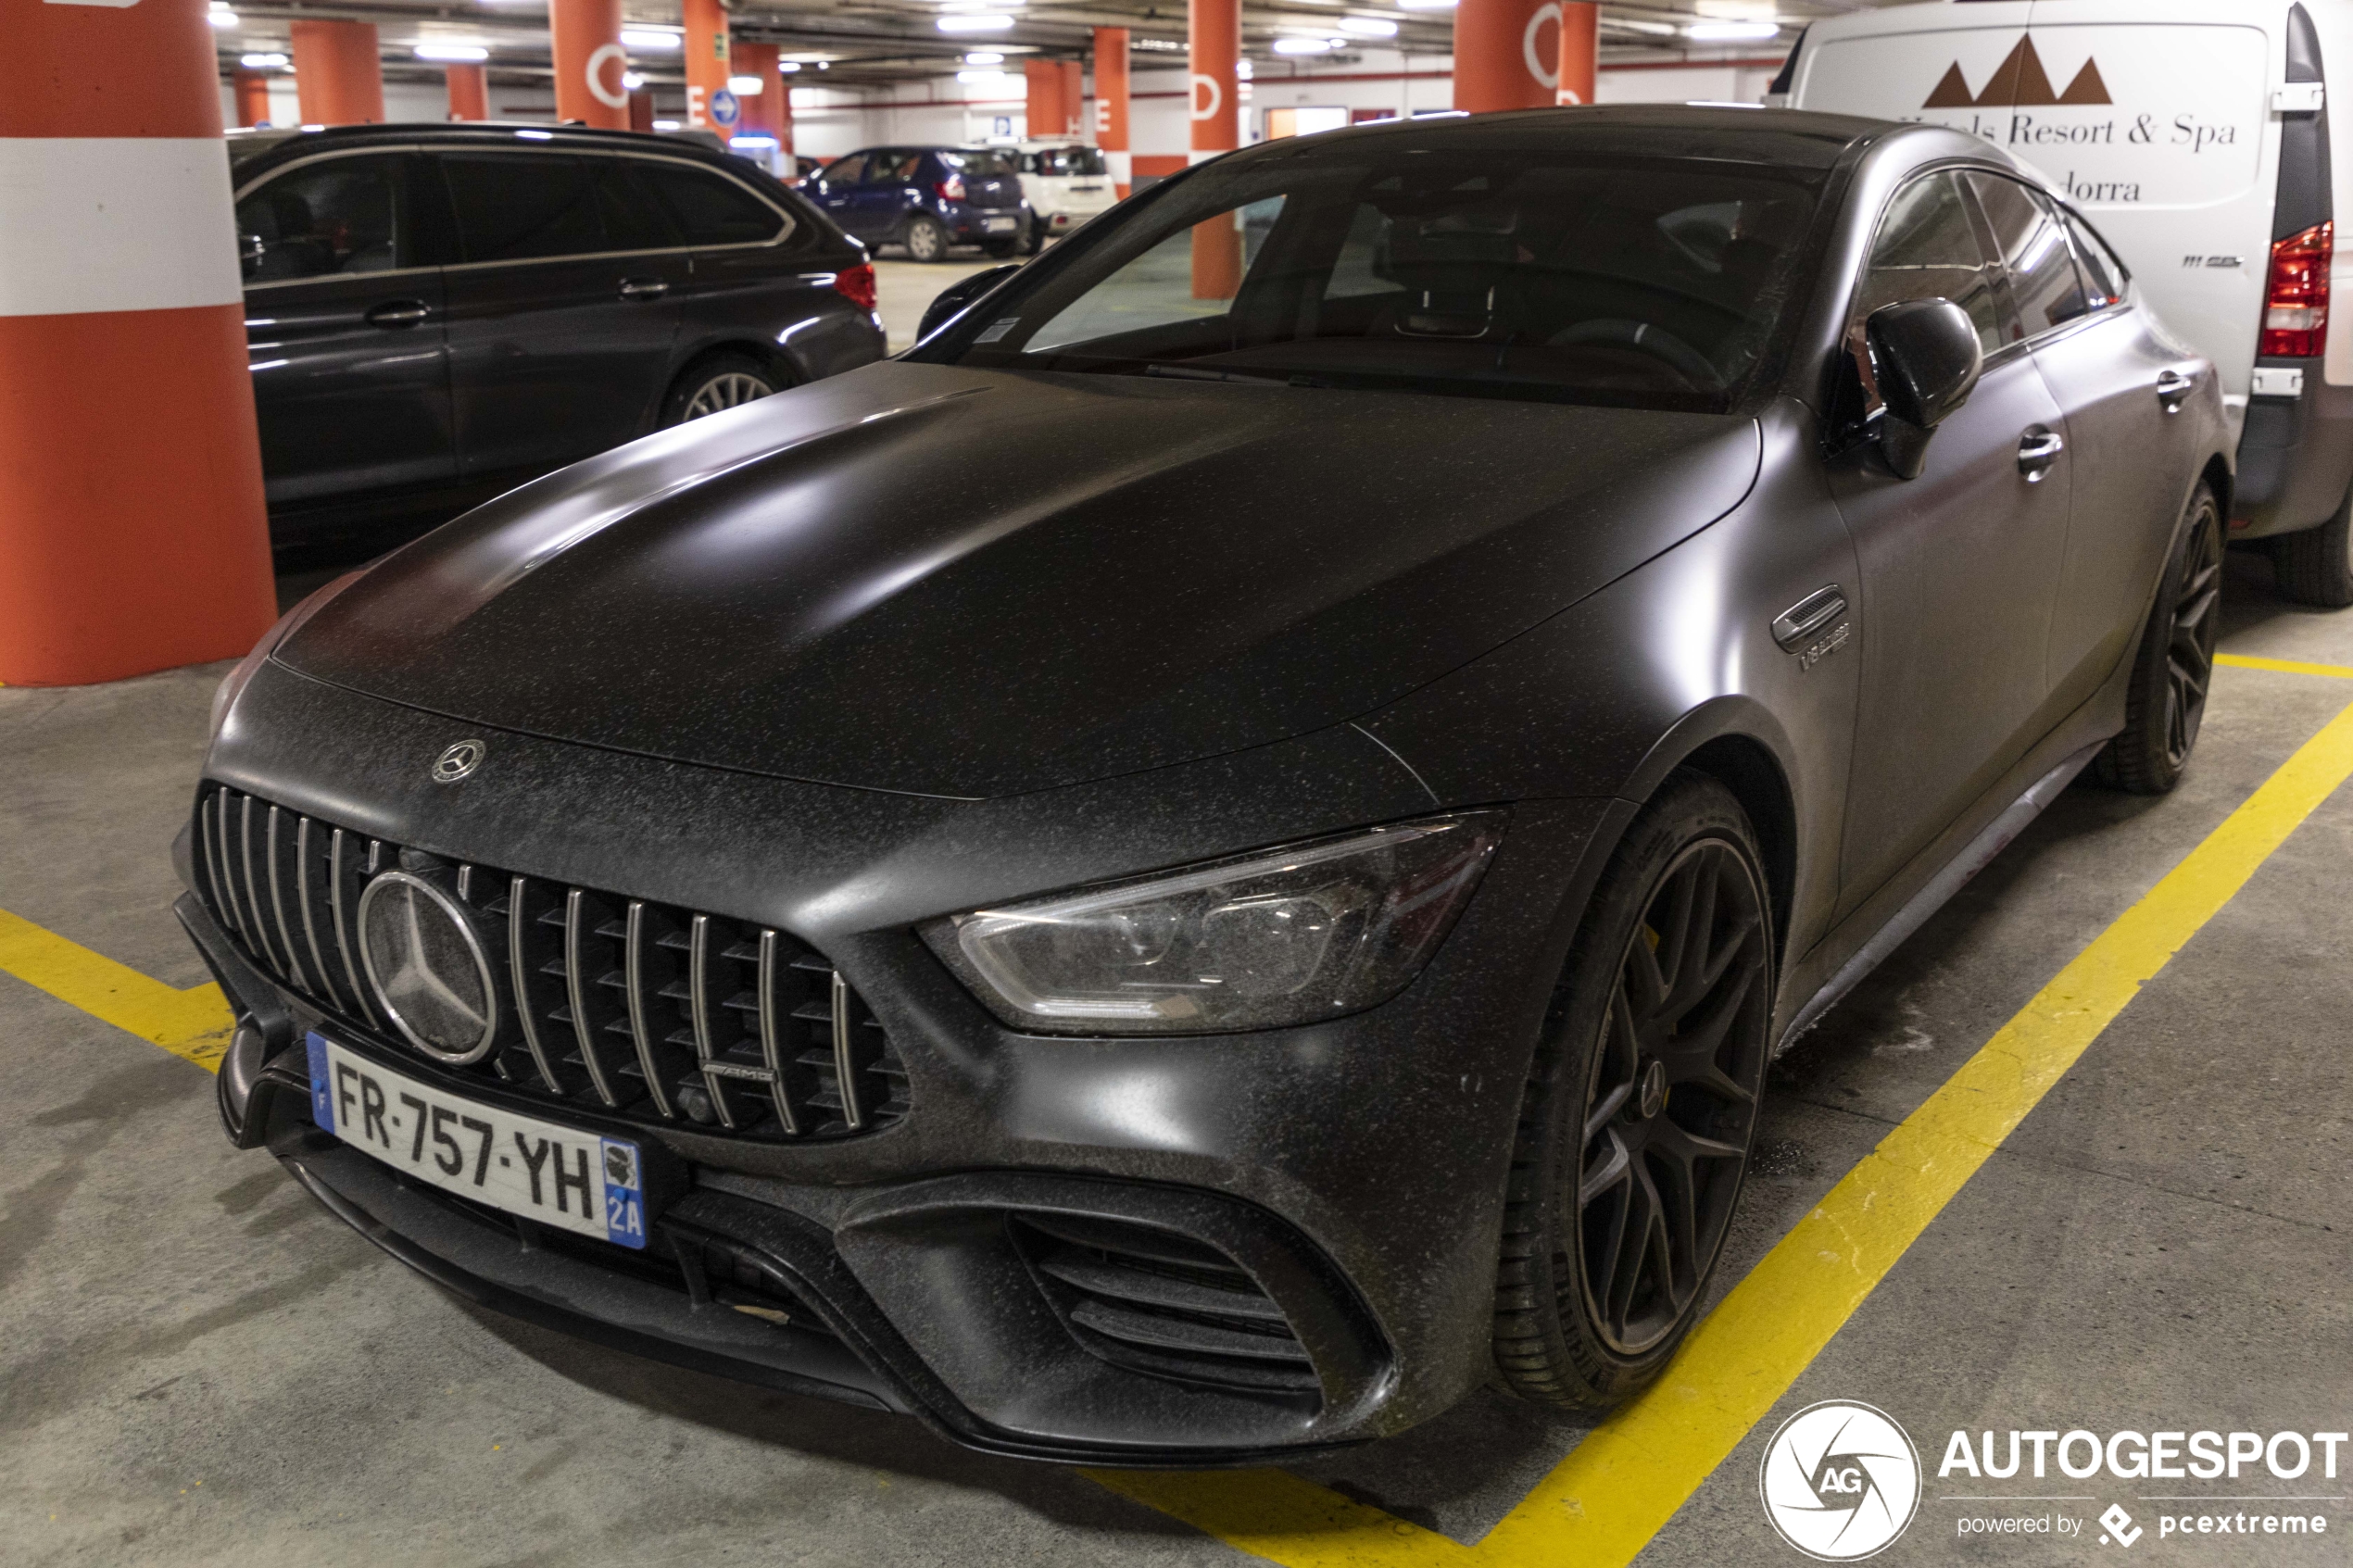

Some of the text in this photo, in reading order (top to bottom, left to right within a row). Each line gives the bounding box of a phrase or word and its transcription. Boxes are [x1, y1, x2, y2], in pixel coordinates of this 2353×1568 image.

[686, 85, 705, 126] E
[1094, 99, 1111, 132] E
[1190, 74, 1221, 120] D
[2010, 114, 2114, 144] Resort
[2130, 113, 2158, 144] &
[2171, 113, 2236, 153] Spa
[2058, 171, 2139, 201] dorra
[335, 1060, 594, 1221] FR-757-YH
[608, 1196, 643, 1236] 2A
